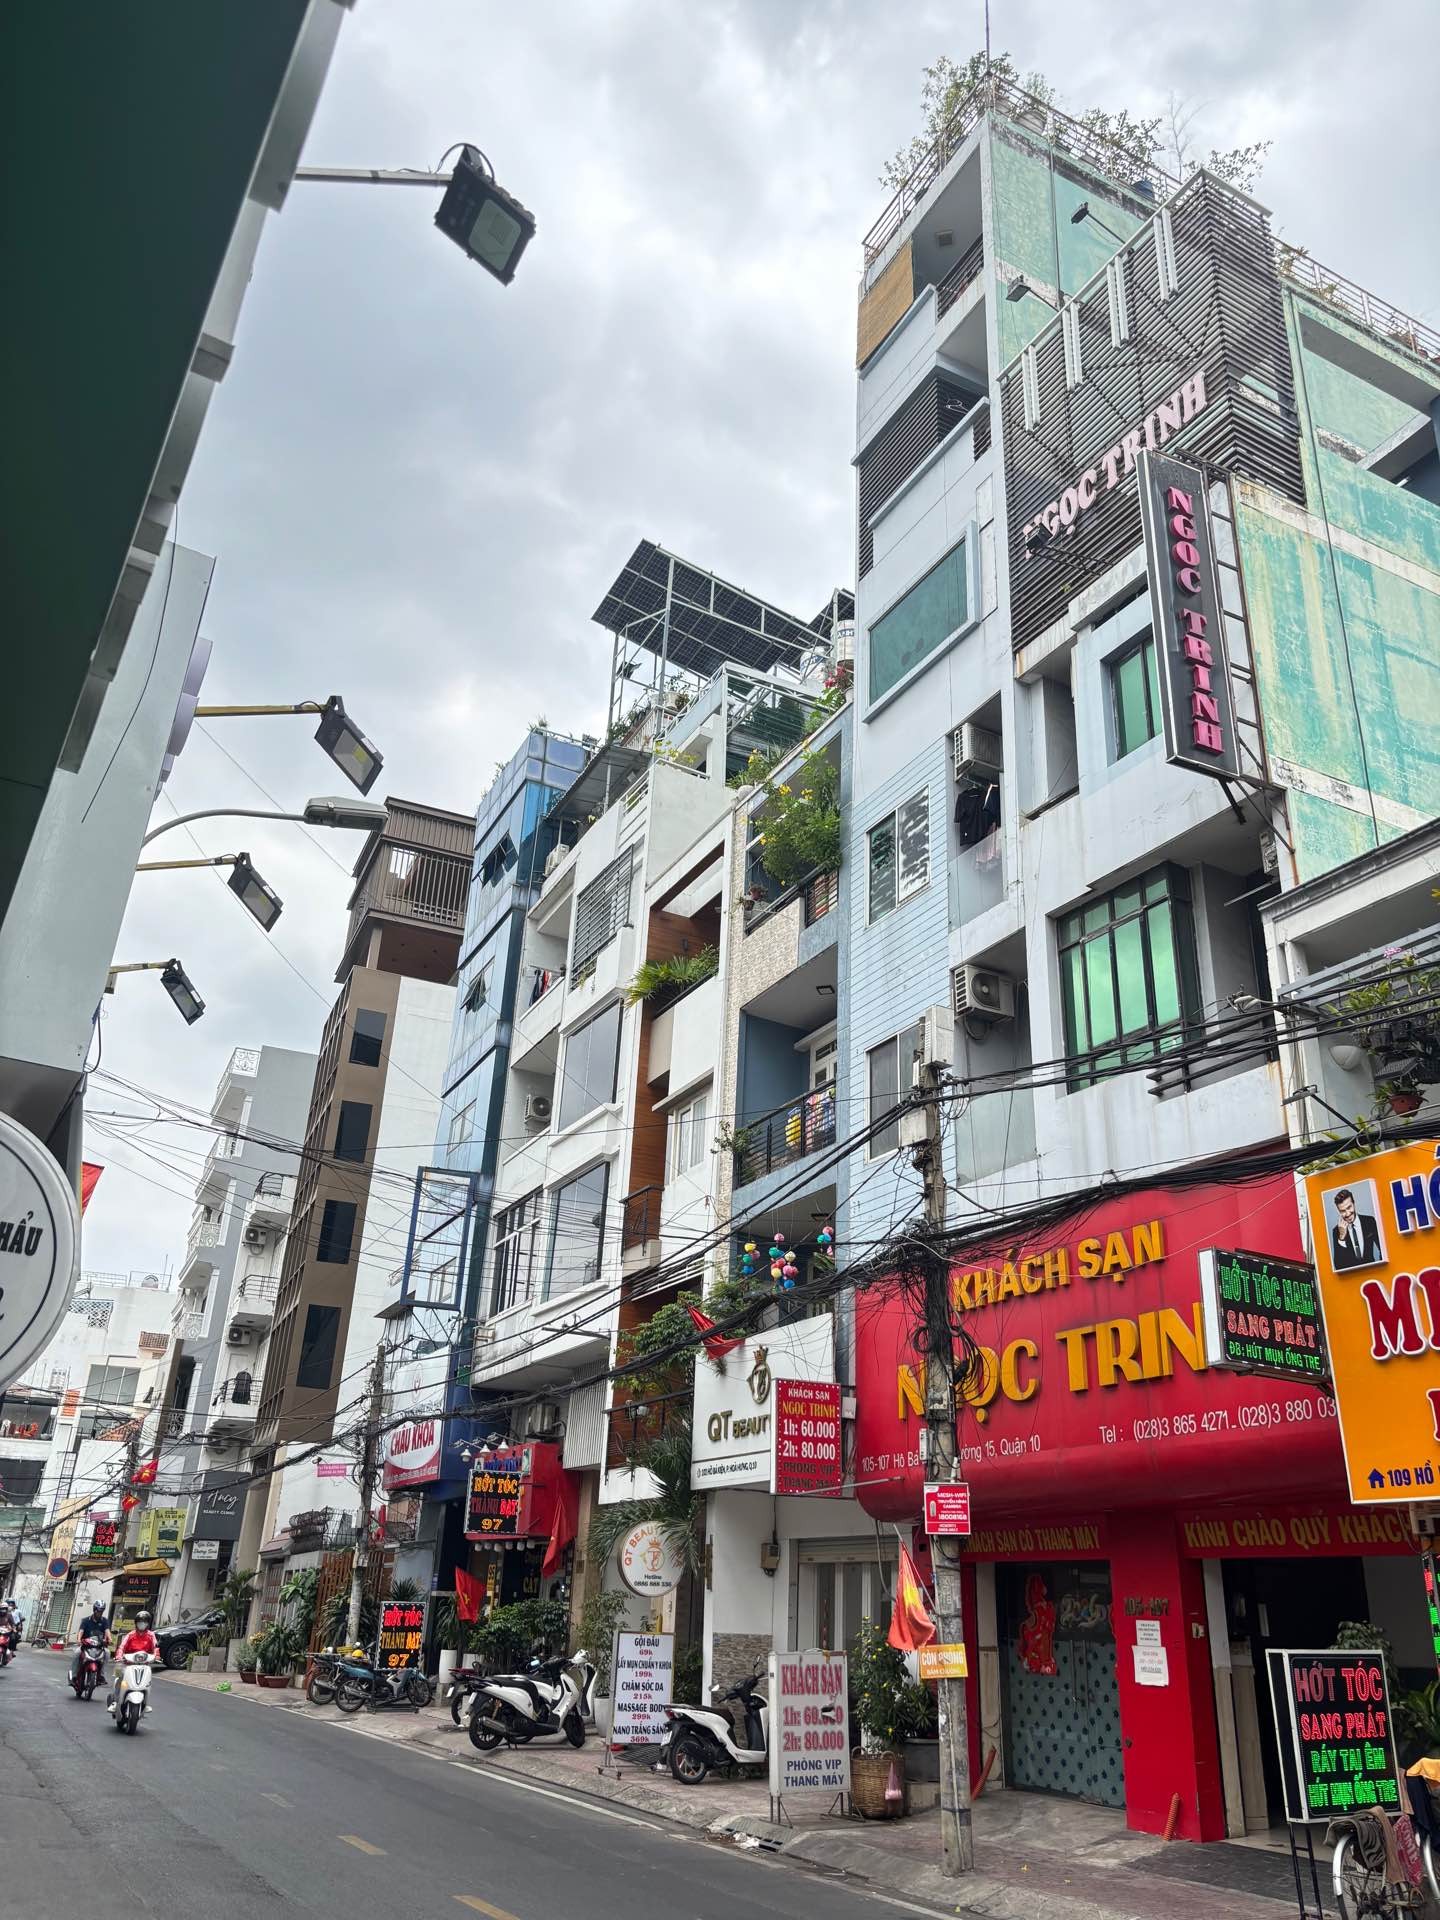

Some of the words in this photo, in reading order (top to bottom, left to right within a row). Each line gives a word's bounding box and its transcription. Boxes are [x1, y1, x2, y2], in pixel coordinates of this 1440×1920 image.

[1101, 370, 1207, 489] TRINH
[1179, 607, 1225, 756] TRINH
[953, 1248, 1072, 1312] KHÁCH
[1077, 1220, 1165, 1286] SẠN
[1220, 1258, 1250, 1302] HỚT
[1252, 1265, 1282, 1310] TÓC
[1282, 1278, 1315, 1316] NAM
[1226, 1310, 1270, 1339] SANG
[1273, 1316, 1316, 1348] PHÁT
[898, 1338, 1040, 1424] NỌC
[1056, 1302, 1208, 1392] TRIN
[1246, 1342, 1262, 1360] HÚT
[1264, 1347, 1284, 1365] MỤN
[1285, 1346, 1303, 1367] ỐNG
[1303, 1354, 1321, 1370] TRE
[788, 1386, 813, 1400] KHÁCH
[815, 1390, 830, 1402] SẠN
[782, 1400, 806, 1418] NGỌC
[809, 1402, 836, 1418] TRINH
[1134, 1416, 1169, 1442] (028)3
[1173, 1414, 1197, 1434] 865
[1286, 1399, 1312, 1421] 880
[708, 1410, 733, 1441] QT
[783, 1419, 798, 1436] 1h:
[801, 1420, 836, 1439] 60.000
[782, 1440, 798, 1457] 2h:
[801, 1441, 836, 1460] 80.000
[862, 1454, 889, 1472] 105-107
[1000, 1438, 1027, 1457] Quận
[1029, 1434, 1041, 1452] 10
[497, 1473, 518, 1494] TÓC
[1387, 1469, 1412, 1486] 109
[481, 1518, 503, 1530] 97
[1232, 1512, 1286, 1547] CHÀO
[1290, 1509, 1332, 1550] QUÝ
[388, 1653, 410, 1667] 97
[655, 1682, 664, 1691] DA
[1293, 1660, 1336, 1702] HỚT
[1341, 1660, 1383, 1701] TÓC
[617, 1703, 648, 1712] MASSAGE
[613, 1726, 631, 1735] NANO
[1301, 1712, 1343, 1741] SANG
[1345, 1704, 1386, 1739] PHÁT
[804, 1731, 844, 1752] 80.000
[787, 1756, 822, 1772] PHÒNG
[824, 1759, 842, 1770] VIP
[1310, 1744, 1337, 1773] RÁY
[1339, 1748, 1363, 1771] TAI
[1364, 1741, 1386, 1770] ÊM
[784, 1776, 819, 1787] THANG
[822, 1771, 844, 1786] MÁY
[1307, 1776, 1329, 1807] HÚT
[1353, 1772, 1377, 1804] ỐNG
[1376, 1779, 1399, 1803] TRE
